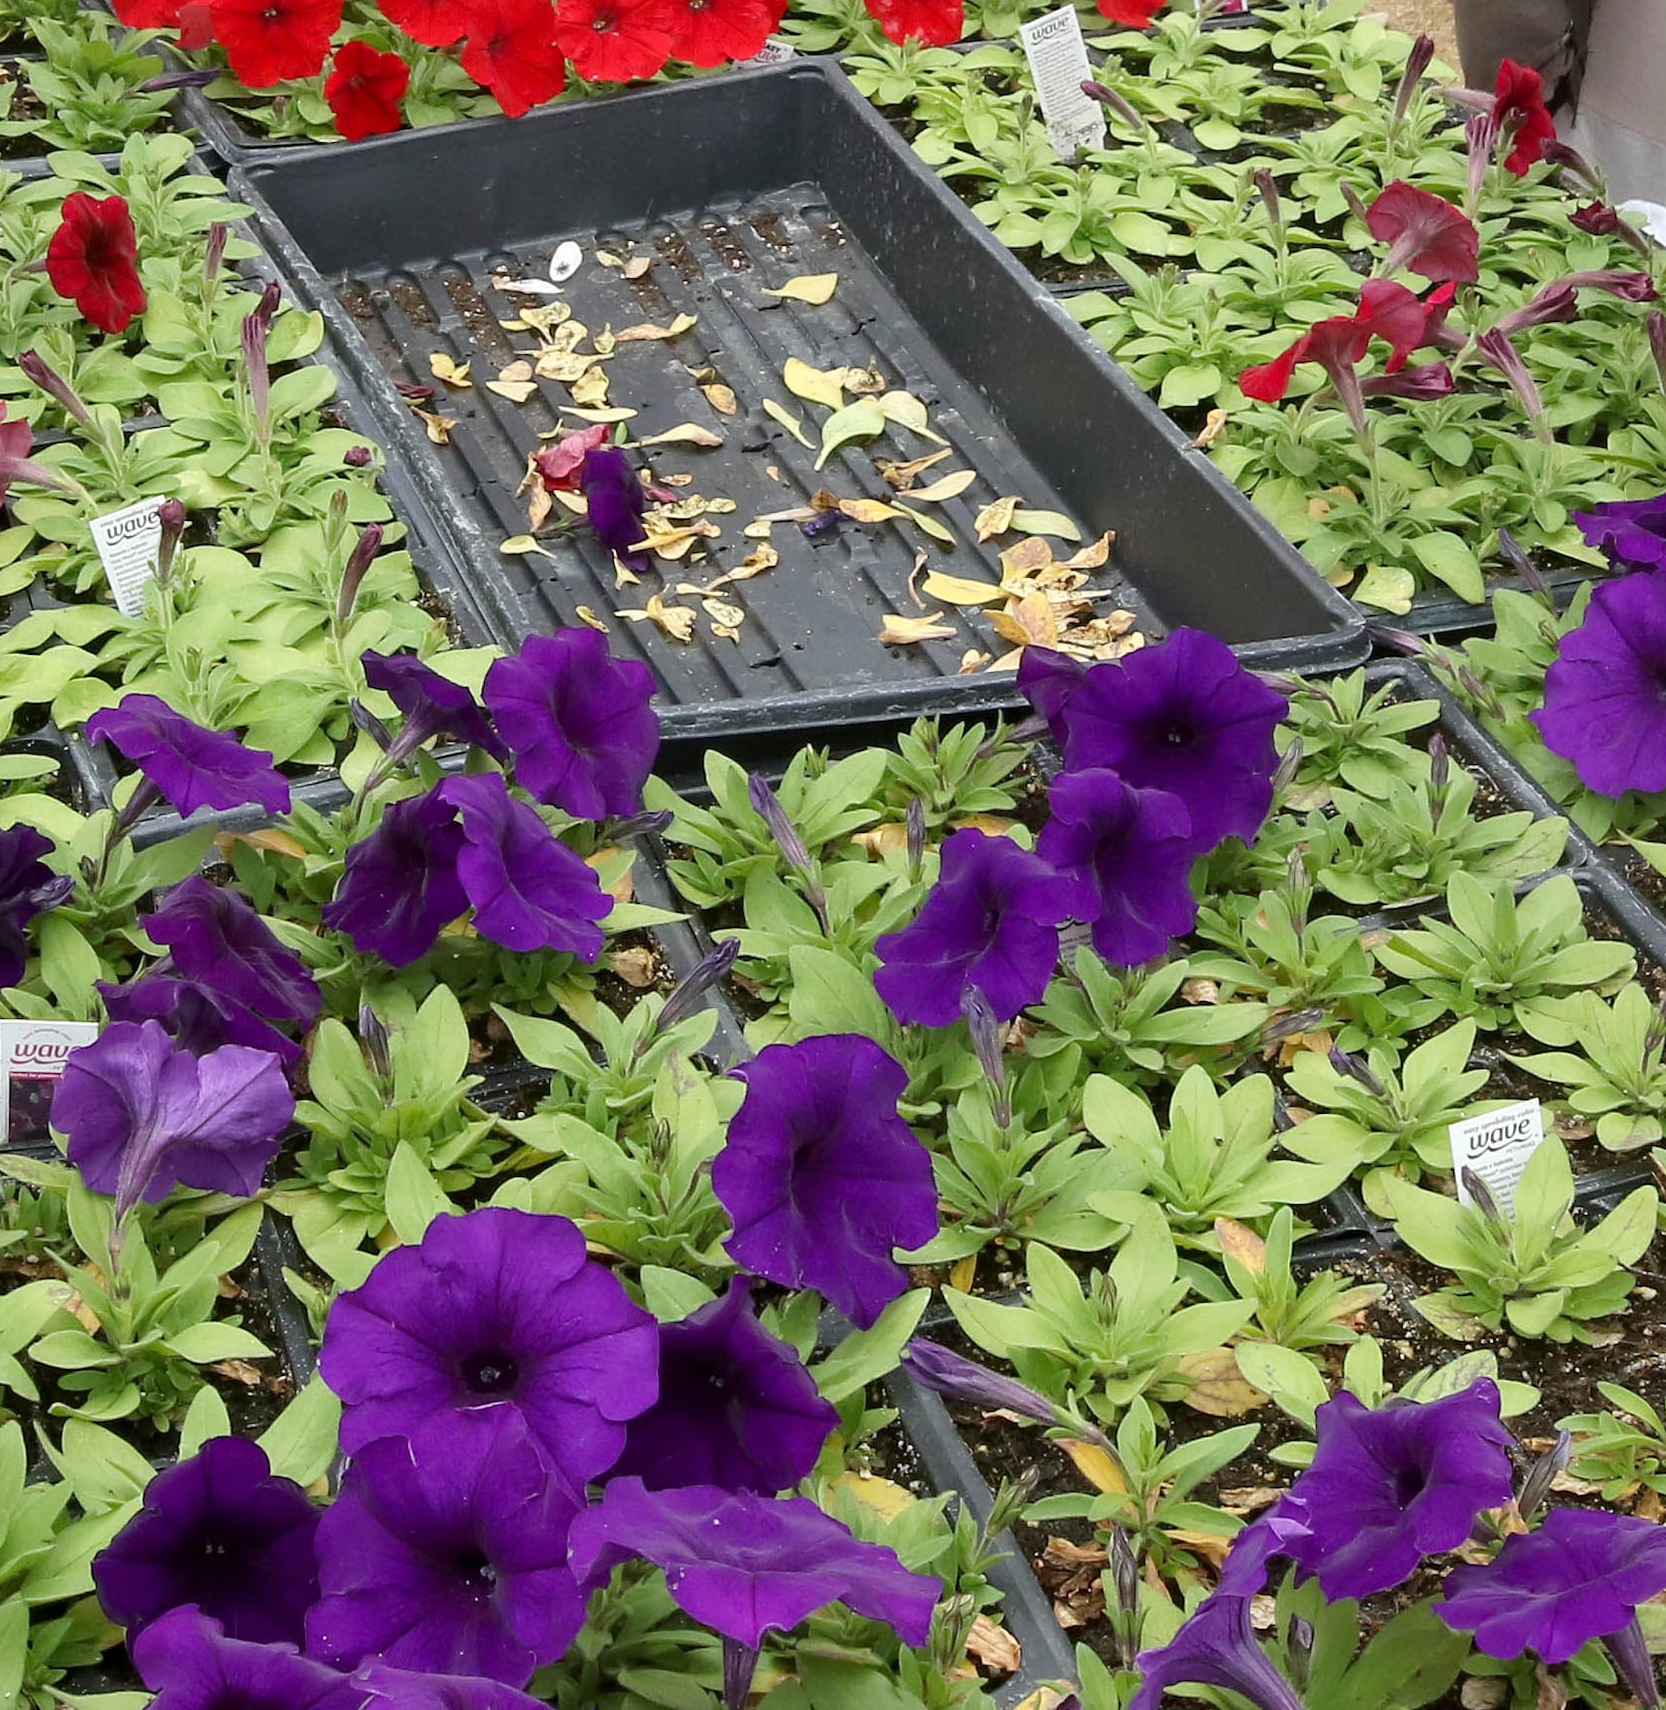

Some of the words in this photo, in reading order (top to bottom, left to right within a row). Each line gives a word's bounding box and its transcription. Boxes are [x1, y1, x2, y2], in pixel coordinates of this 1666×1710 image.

[1031, 16, 1070, 41] wave
[757, 50, 782, 62] ave
[765, 43, 781, 53] ASY
[106, 510, 159, 539] wave
[14, 1043, 71, 1058] wav
[1469, 1118, 1531, 1150] wave
